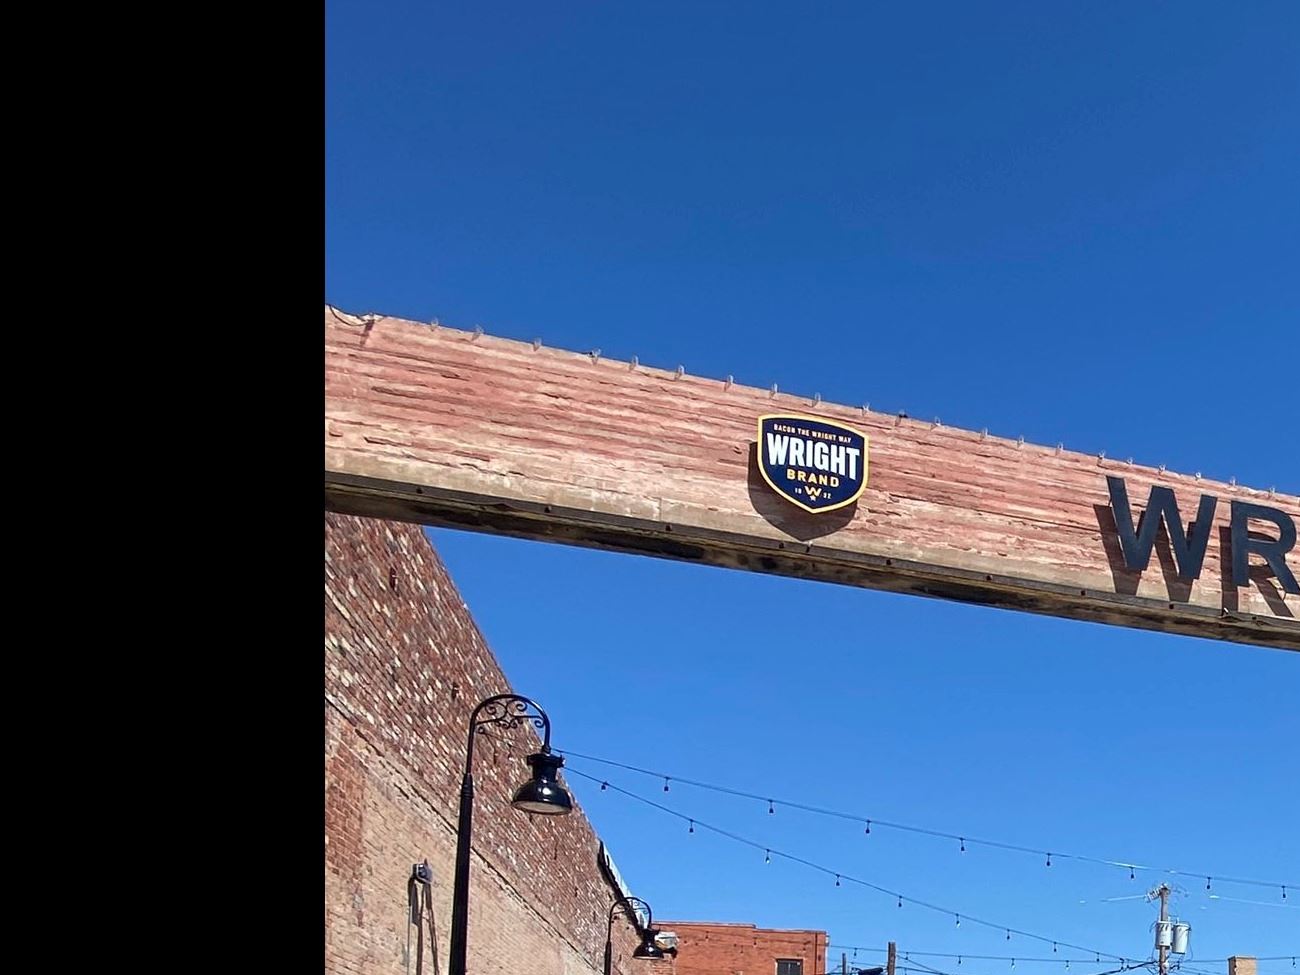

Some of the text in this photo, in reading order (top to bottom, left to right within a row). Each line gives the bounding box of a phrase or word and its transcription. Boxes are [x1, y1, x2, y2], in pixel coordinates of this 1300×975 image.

[774, 423, 852, 443] BACON THE WRIGHT WAY
[766, 432, 860, 481] WRIGHT
[786, 468, 840, 488] BRAND
[804, 485, 822, 497] W
